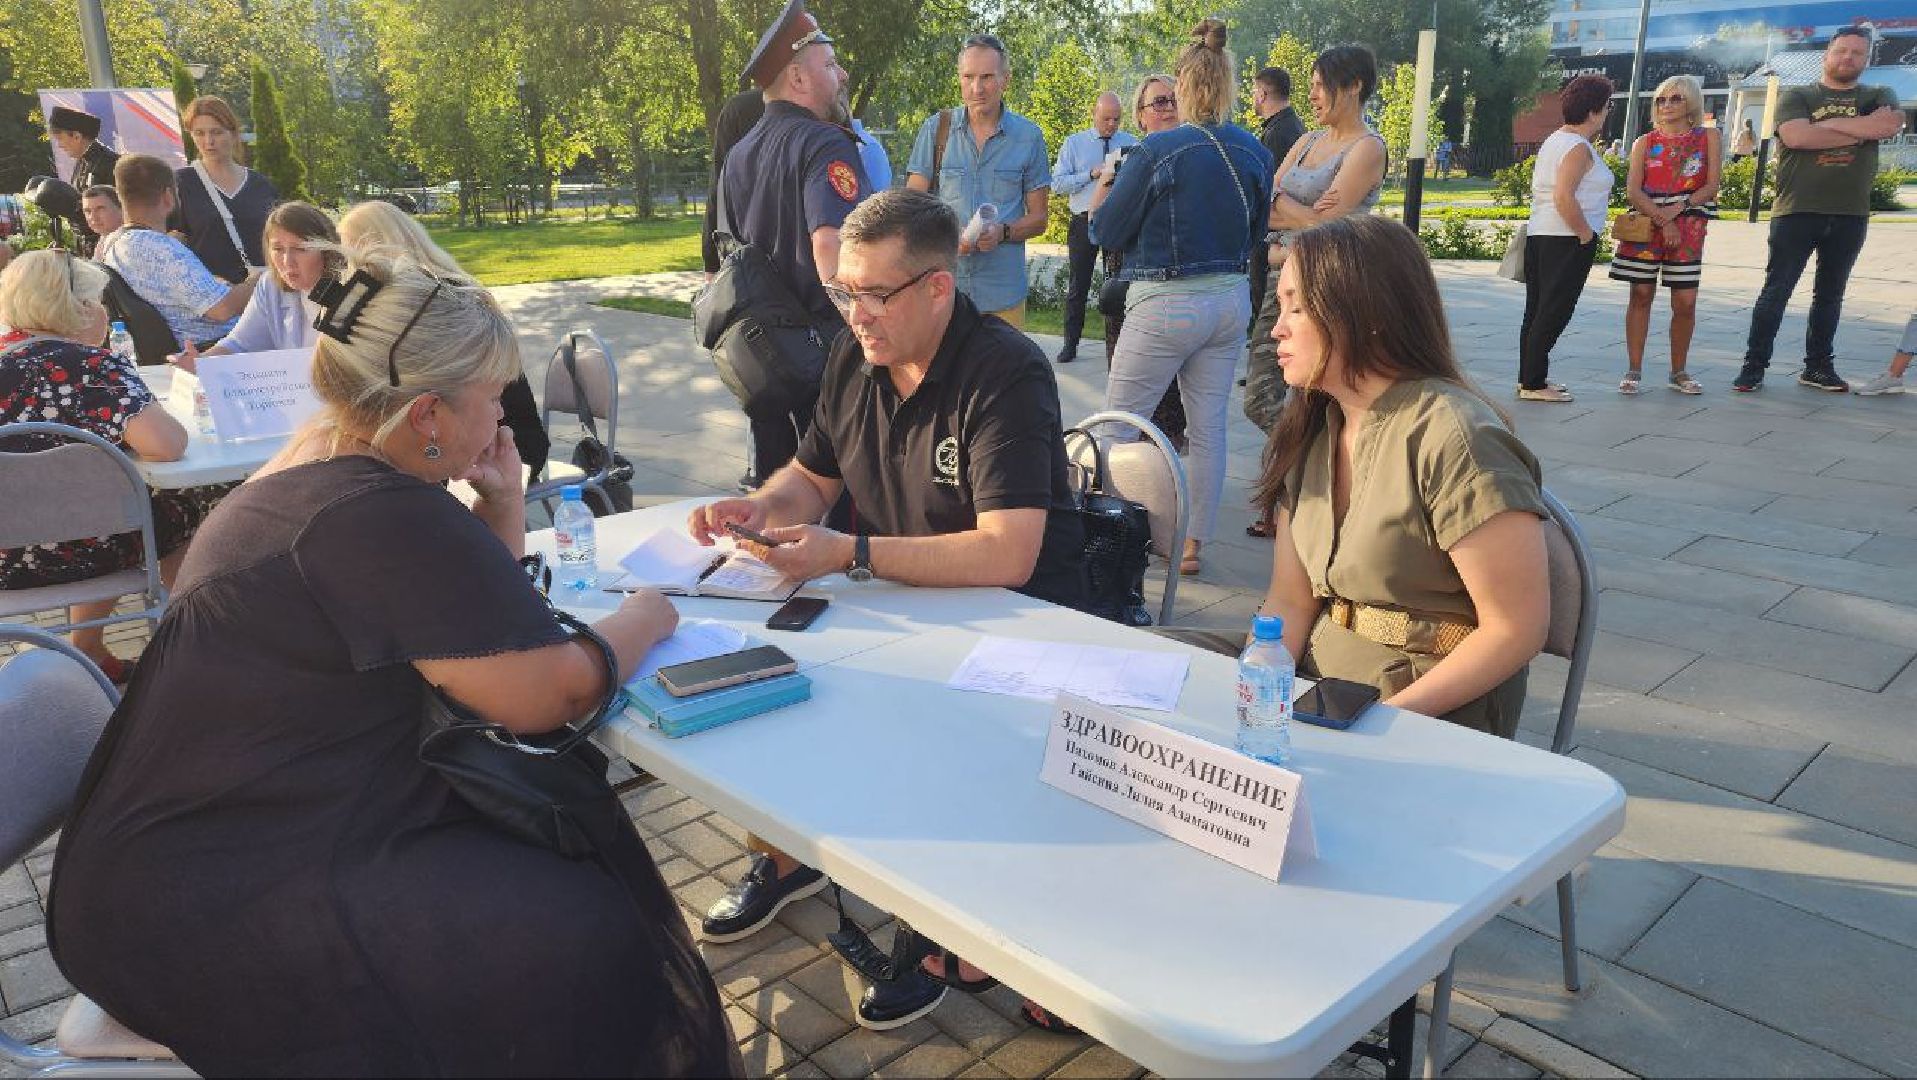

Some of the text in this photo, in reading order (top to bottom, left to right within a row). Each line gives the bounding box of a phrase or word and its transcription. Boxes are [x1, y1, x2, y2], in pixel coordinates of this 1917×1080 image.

[1061, 710, 1287, 811] ЗДРАВООХРАНЕНИЕ
[1065, 740, 1268, 830] Пахомов Александр Сергеевич
[1071, 762, 1251, 847] Гайсина Лилия Азаматовна
